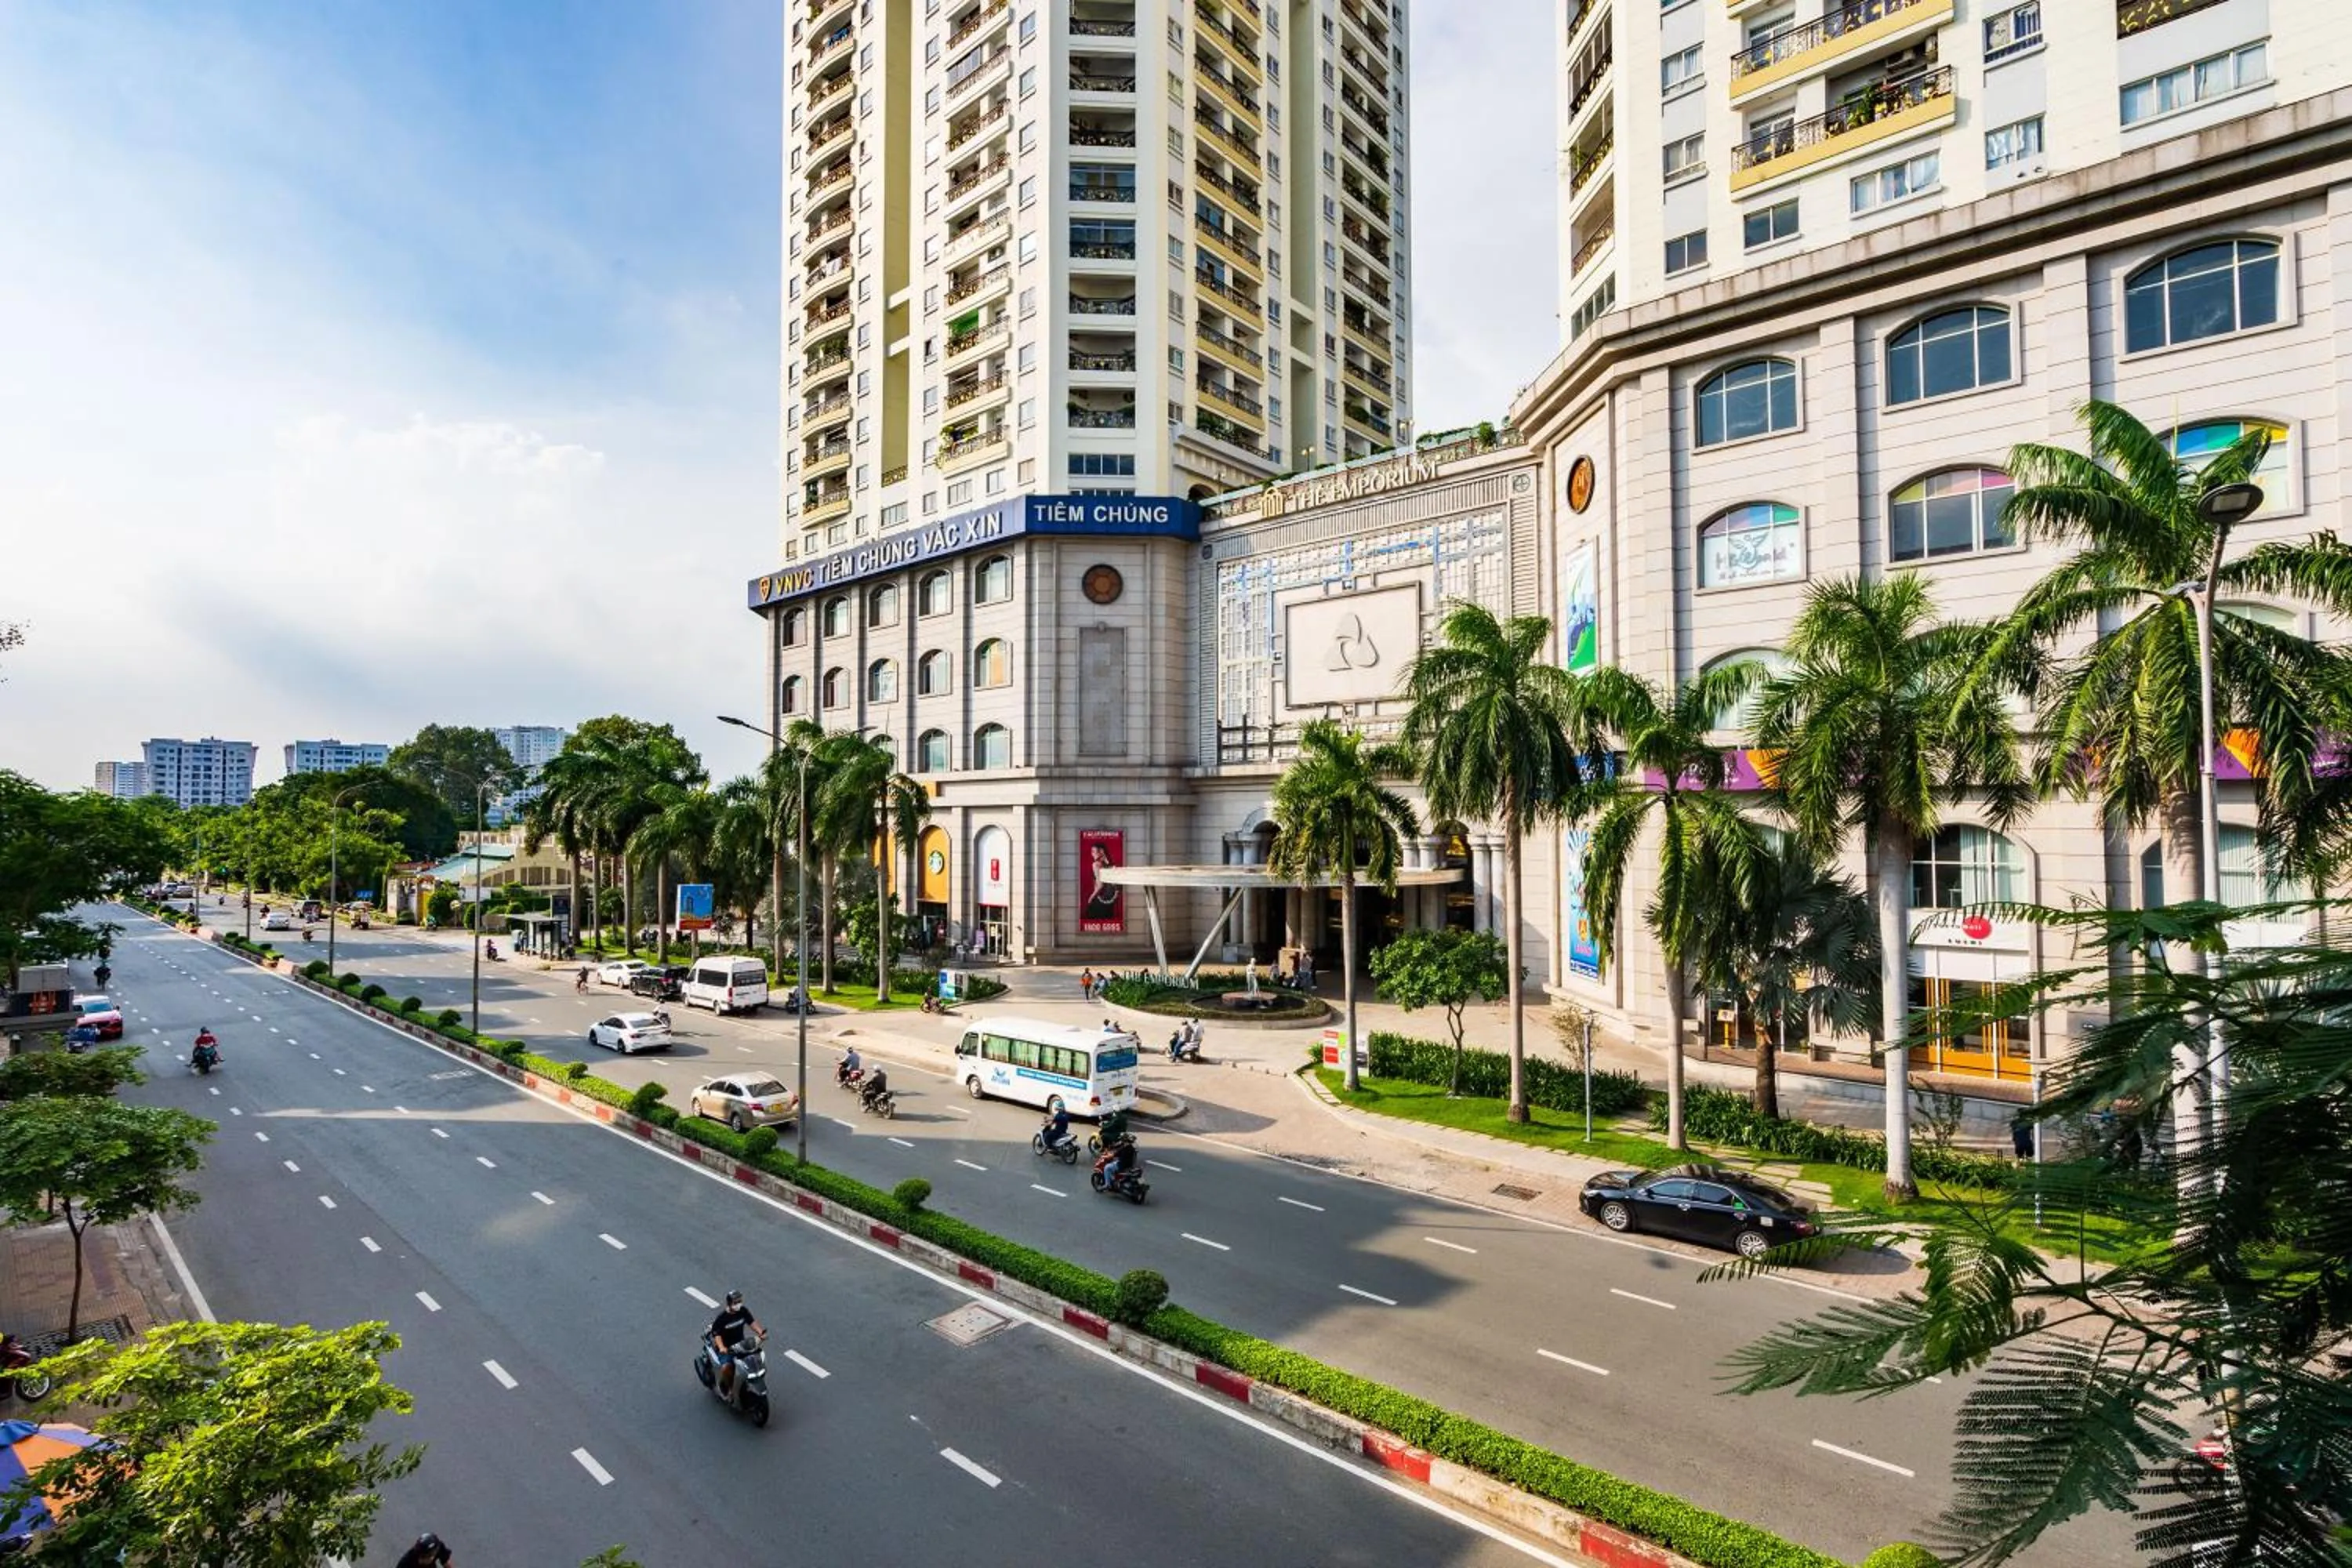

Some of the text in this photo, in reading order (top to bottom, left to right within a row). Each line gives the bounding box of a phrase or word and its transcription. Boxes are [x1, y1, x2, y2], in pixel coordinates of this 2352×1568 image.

[1288, 462, 1437, 509] THE EMPORIUM
[1033, 502, 1169, 524] TIÊM CHỦNG
[775, 568, 815, 596] VNVC
[818, 554, 855, 585] TIÊM
[966, 510, 1004, 542] XIN
